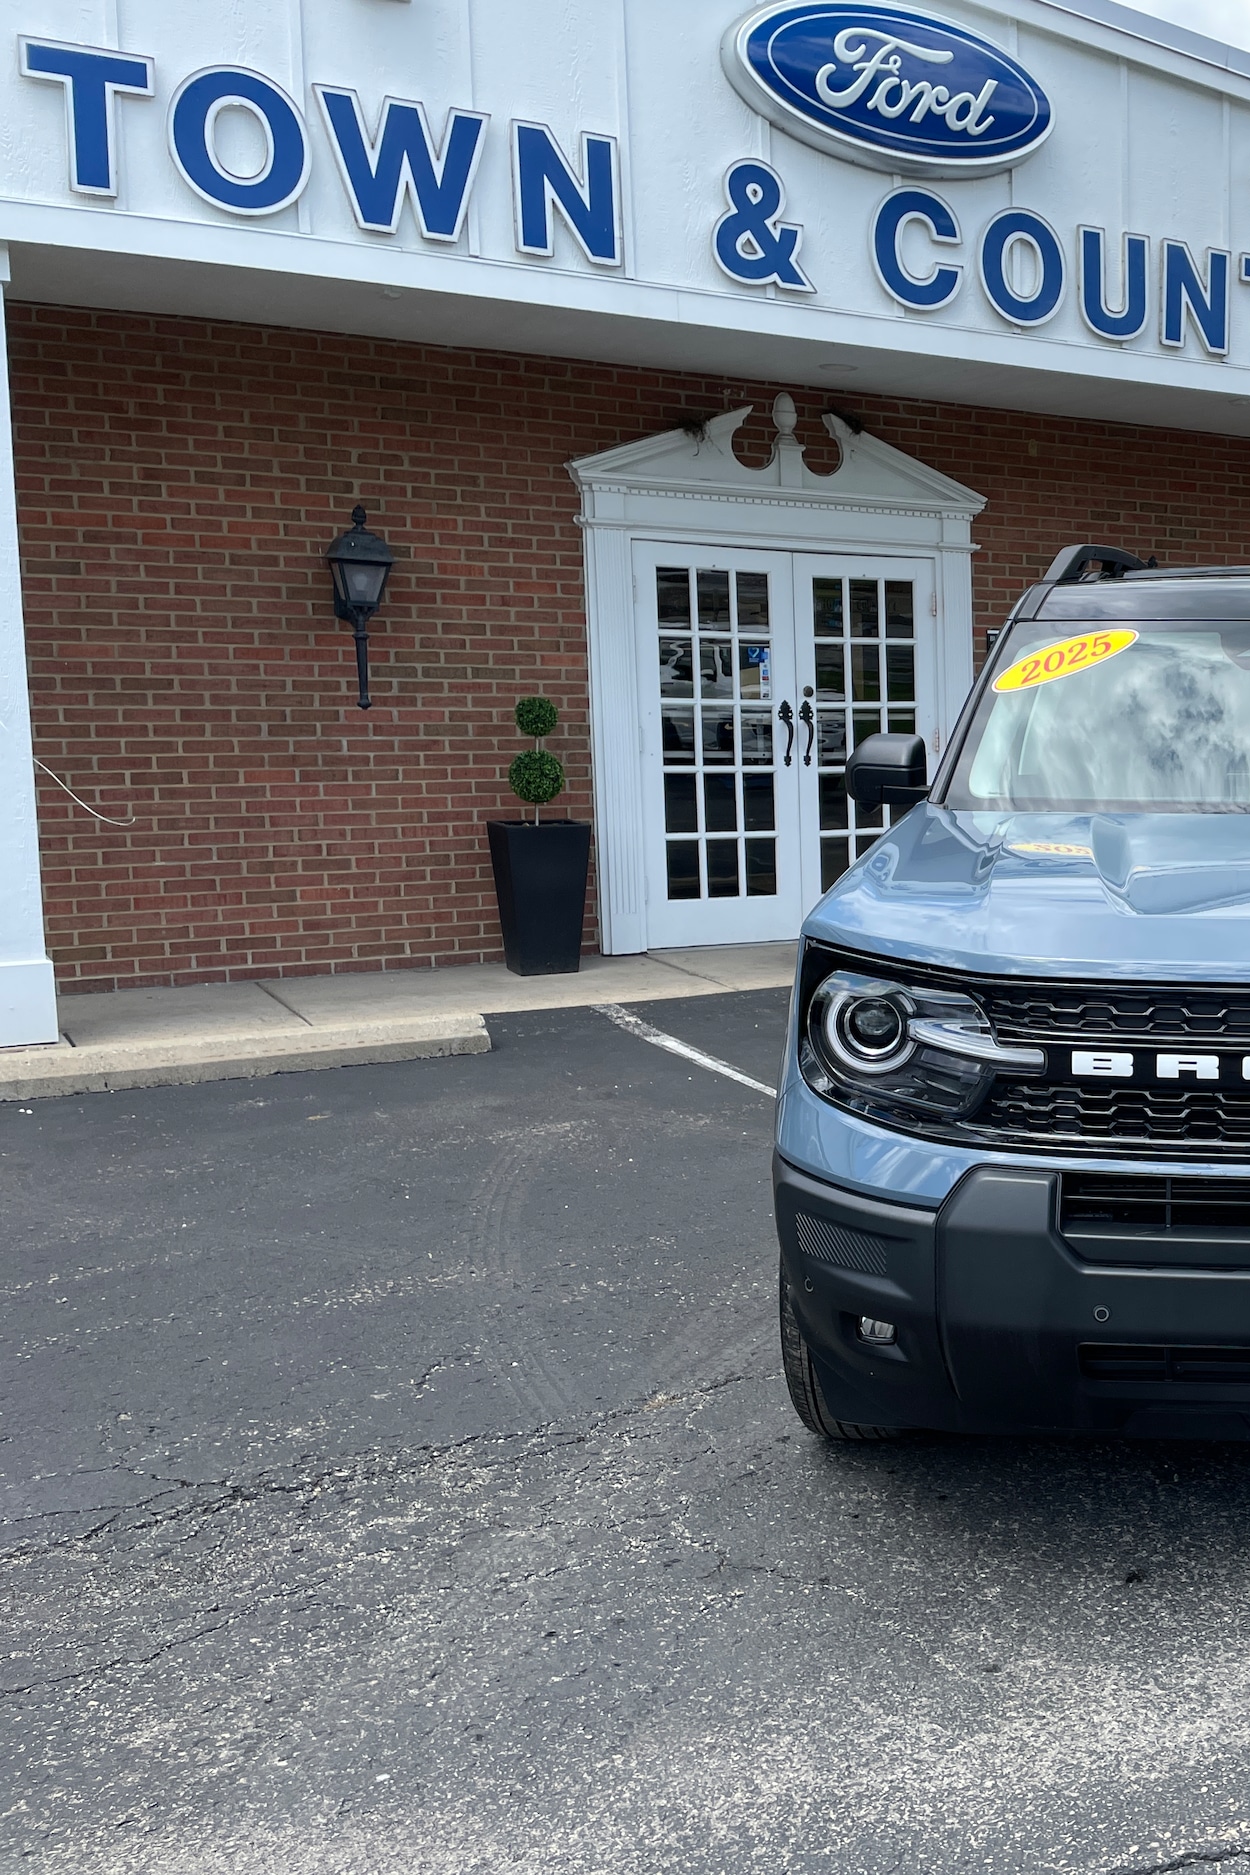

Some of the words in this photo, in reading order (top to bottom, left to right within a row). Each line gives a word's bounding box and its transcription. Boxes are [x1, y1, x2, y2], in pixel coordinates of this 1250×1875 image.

[815, 26, 999, 137] Ford
[20, 37, 620, 264] TOWN
[714, 159, 815, 293] &
[1020, 633, 1112, 685] 2025
